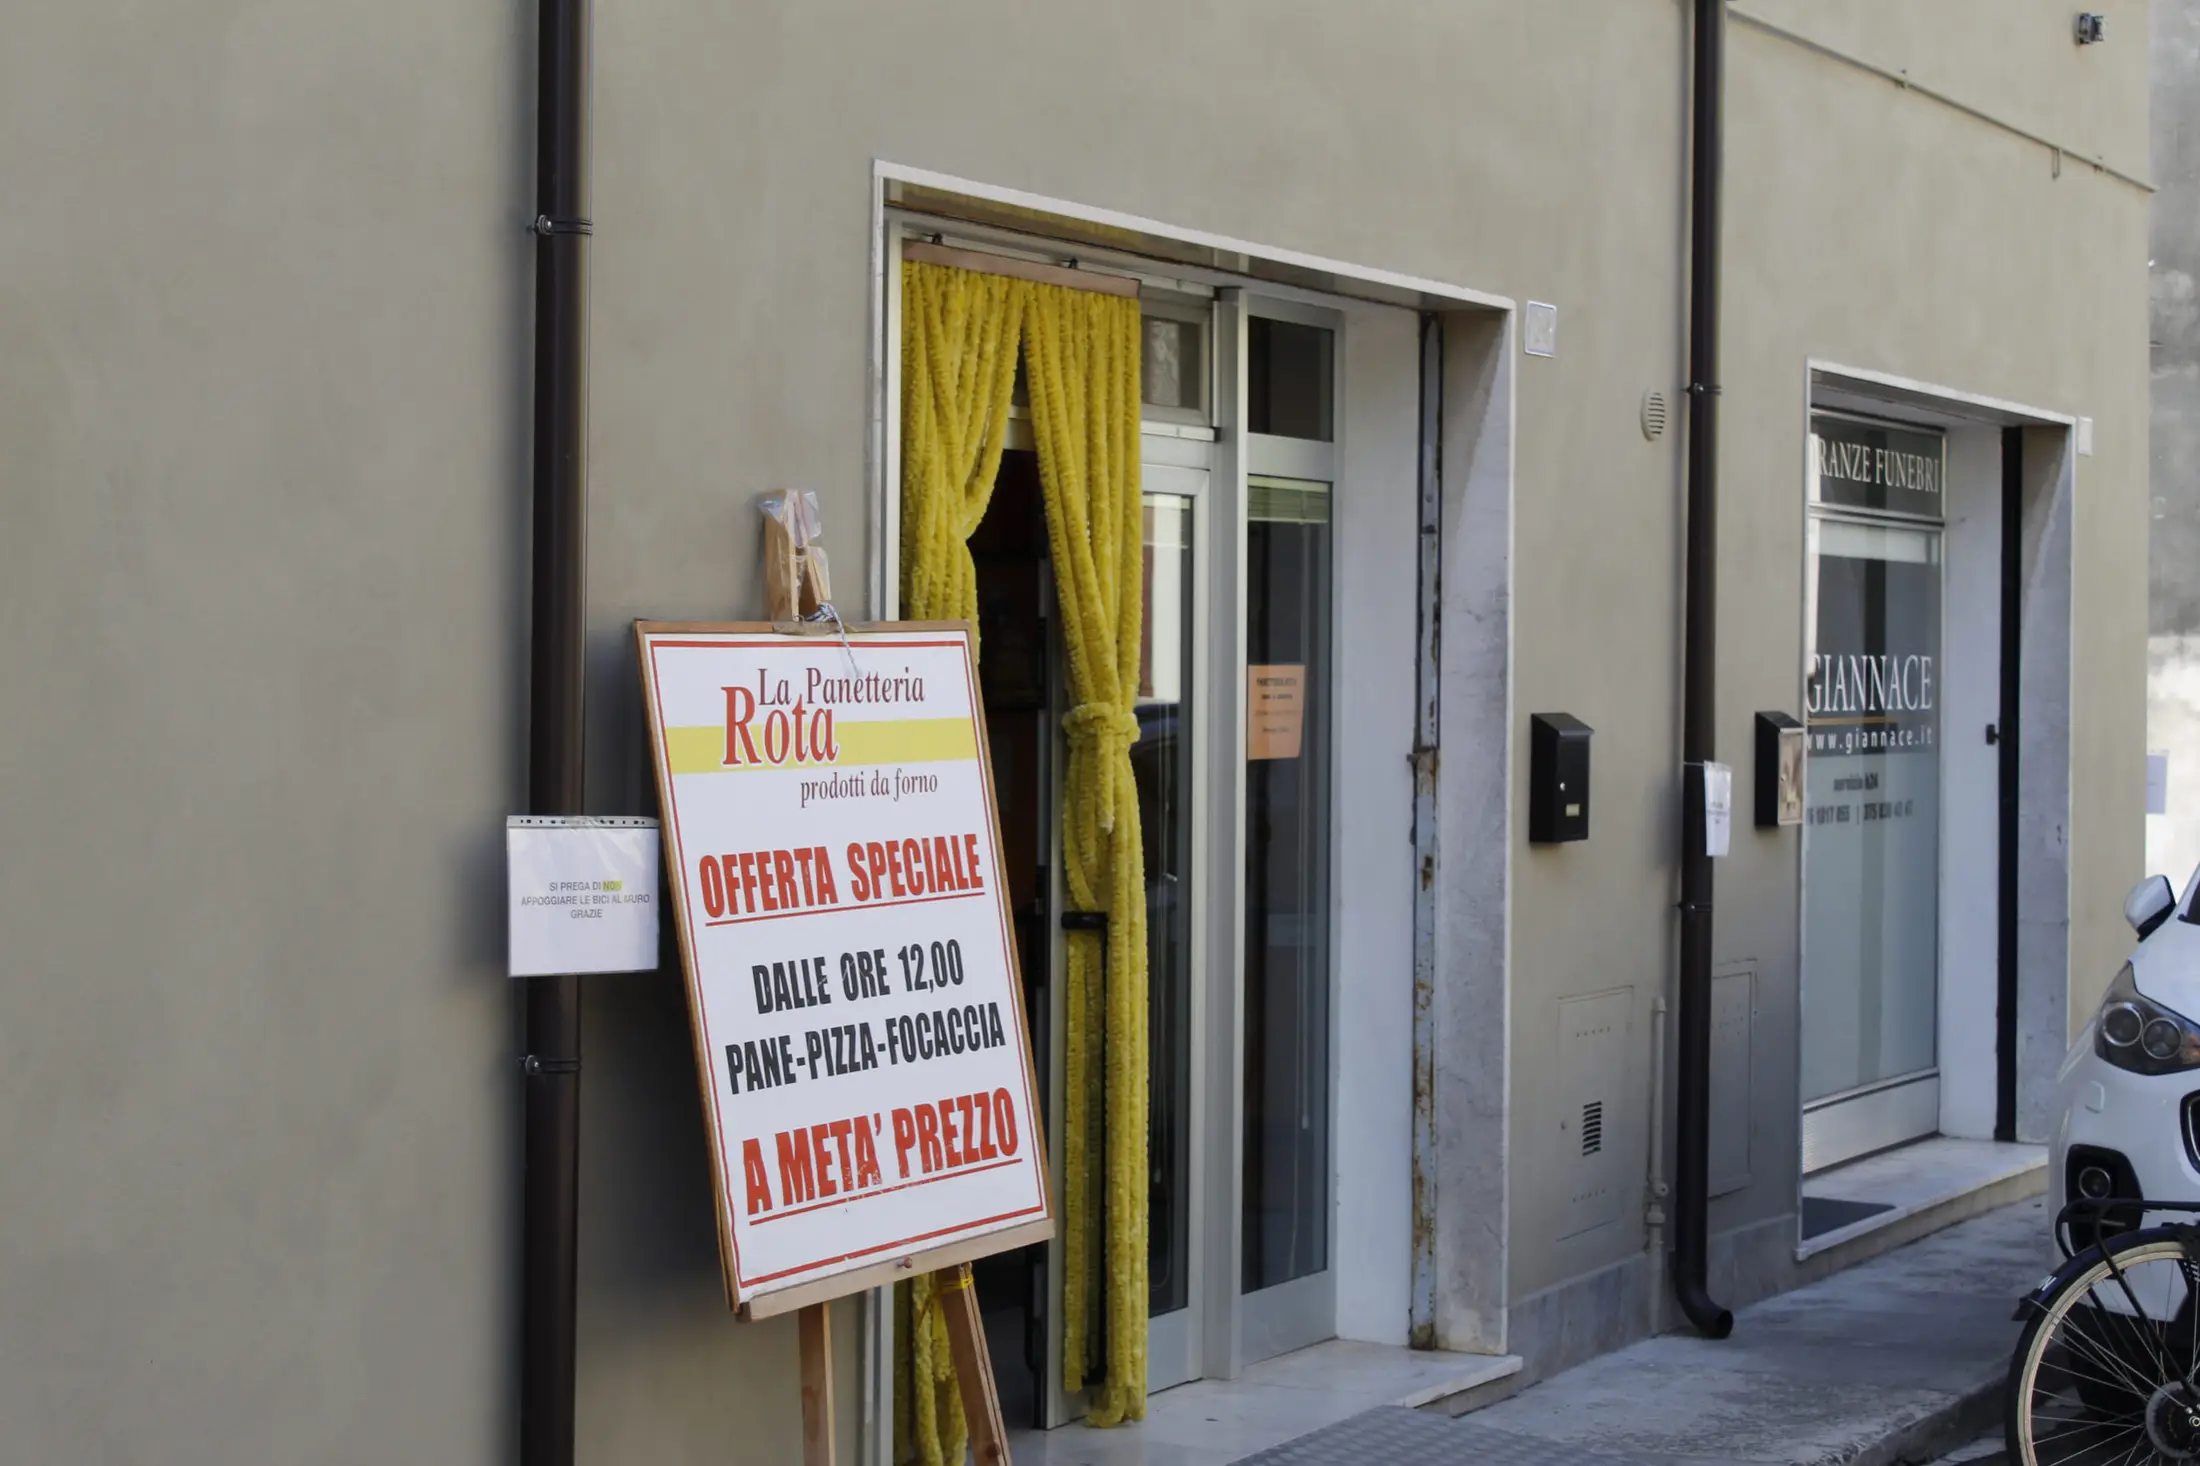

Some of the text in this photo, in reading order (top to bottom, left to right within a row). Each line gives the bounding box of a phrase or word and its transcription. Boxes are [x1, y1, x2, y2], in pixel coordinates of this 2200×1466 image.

[1810, 435, 1939, 493] RANZE FUNEBRI
[757, 666, 925, 706] La Panetteria
[1806, 653, 1932, 713] GIANNACE
[720, 686, 839, 765] Rota
[800, 767, 938, 809] prodotti da forno
[521, 895, 578, 906] APPOGGIARE
[580, 895, 591, 905] LE
[592, 895, 609, 905] BICI
[611, 894, 622, 904] AL
[549, 881, 558, 892] SI
[560, 881, 590, 892] PREGA
[592, 881, 601, 891] DI
[699, 833, 983, 918] OFFERTA SPECIALE
[570, 908, 603, 919] GRAZIE
[751, 938, 964, 1014] DALLE ORE 12,00
[725, 1001, 1006, 1095] PANE-PIZZA-FOCACCIA
[742, 1087, 1018, 1215] A META' PREZZO
